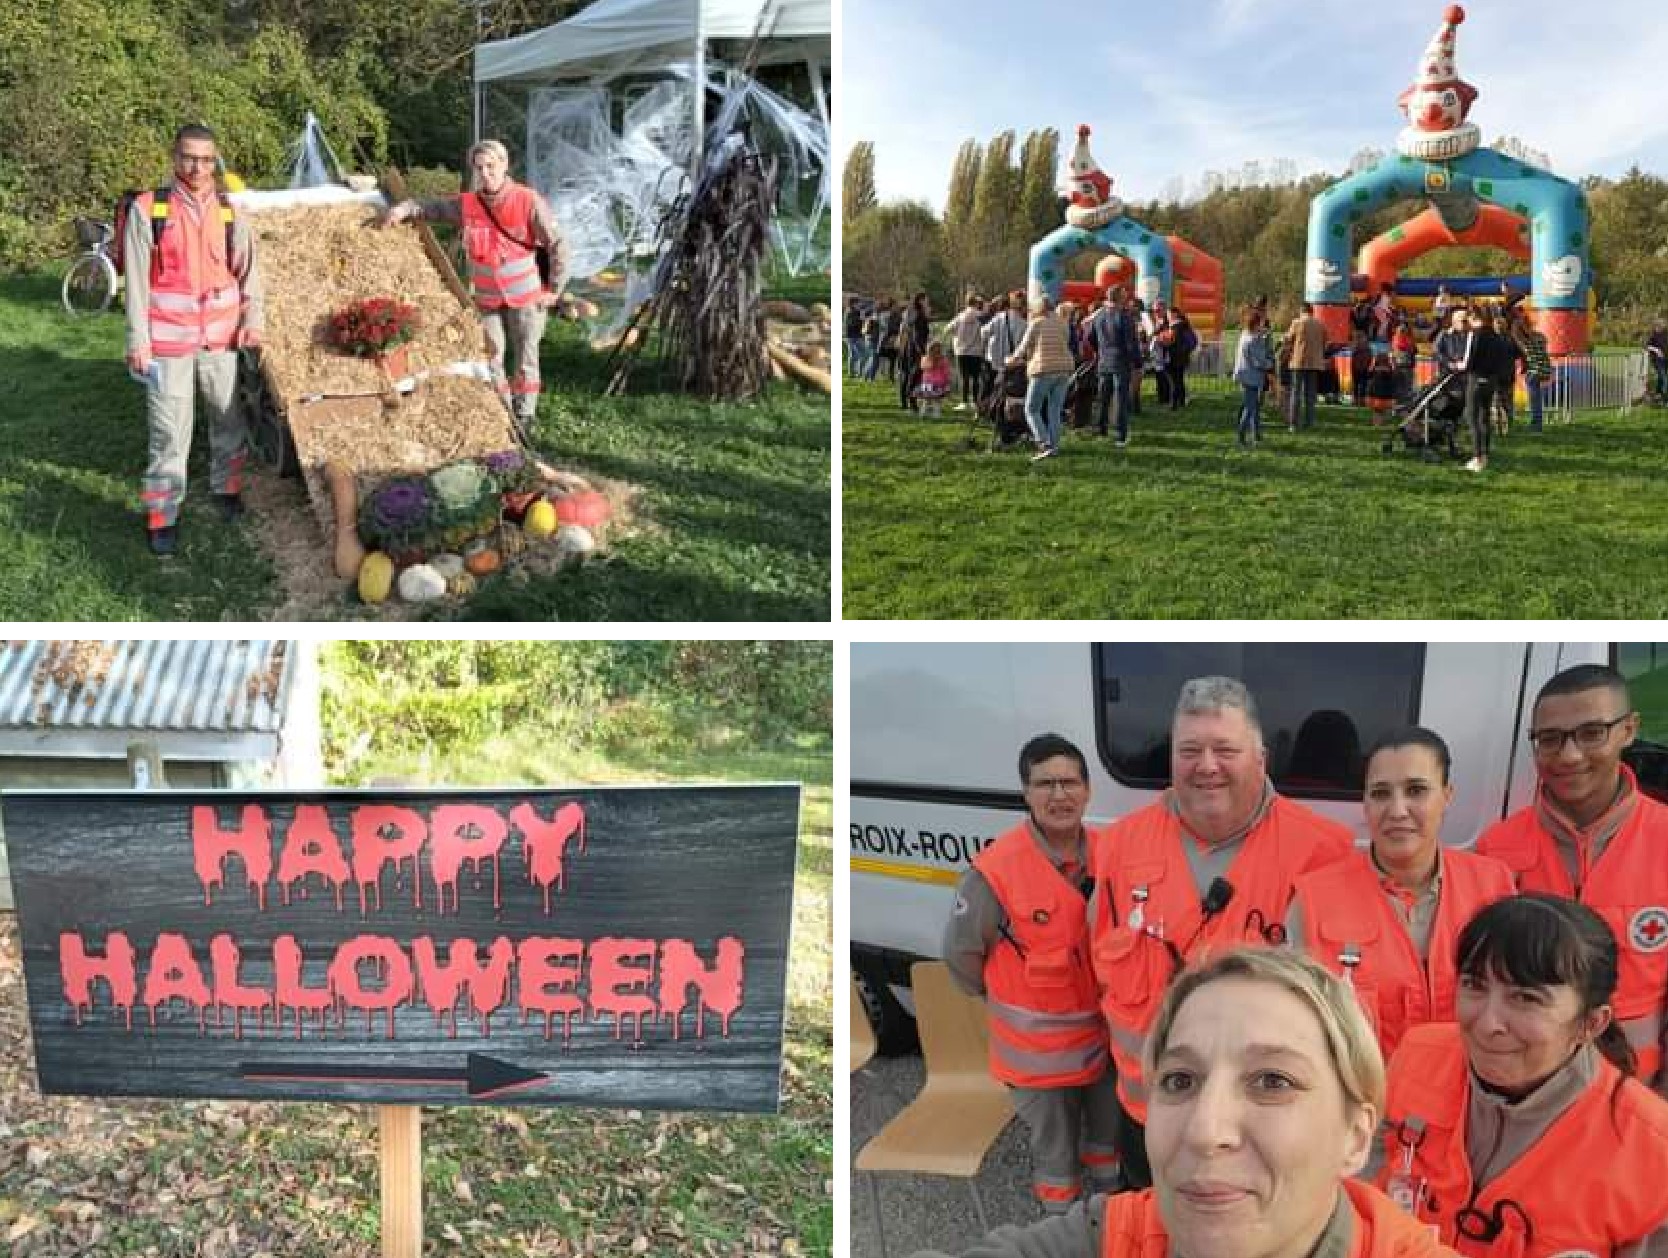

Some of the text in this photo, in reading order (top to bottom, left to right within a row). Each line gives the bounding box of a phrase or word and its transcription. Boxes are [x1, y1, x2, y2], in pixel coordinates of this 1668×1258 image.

[191, 803, 587, 914] HAPPY
[850, 823, 996, 863] ROIX-ROU
[59, 931, 744, 1040] HALLOWEEN
